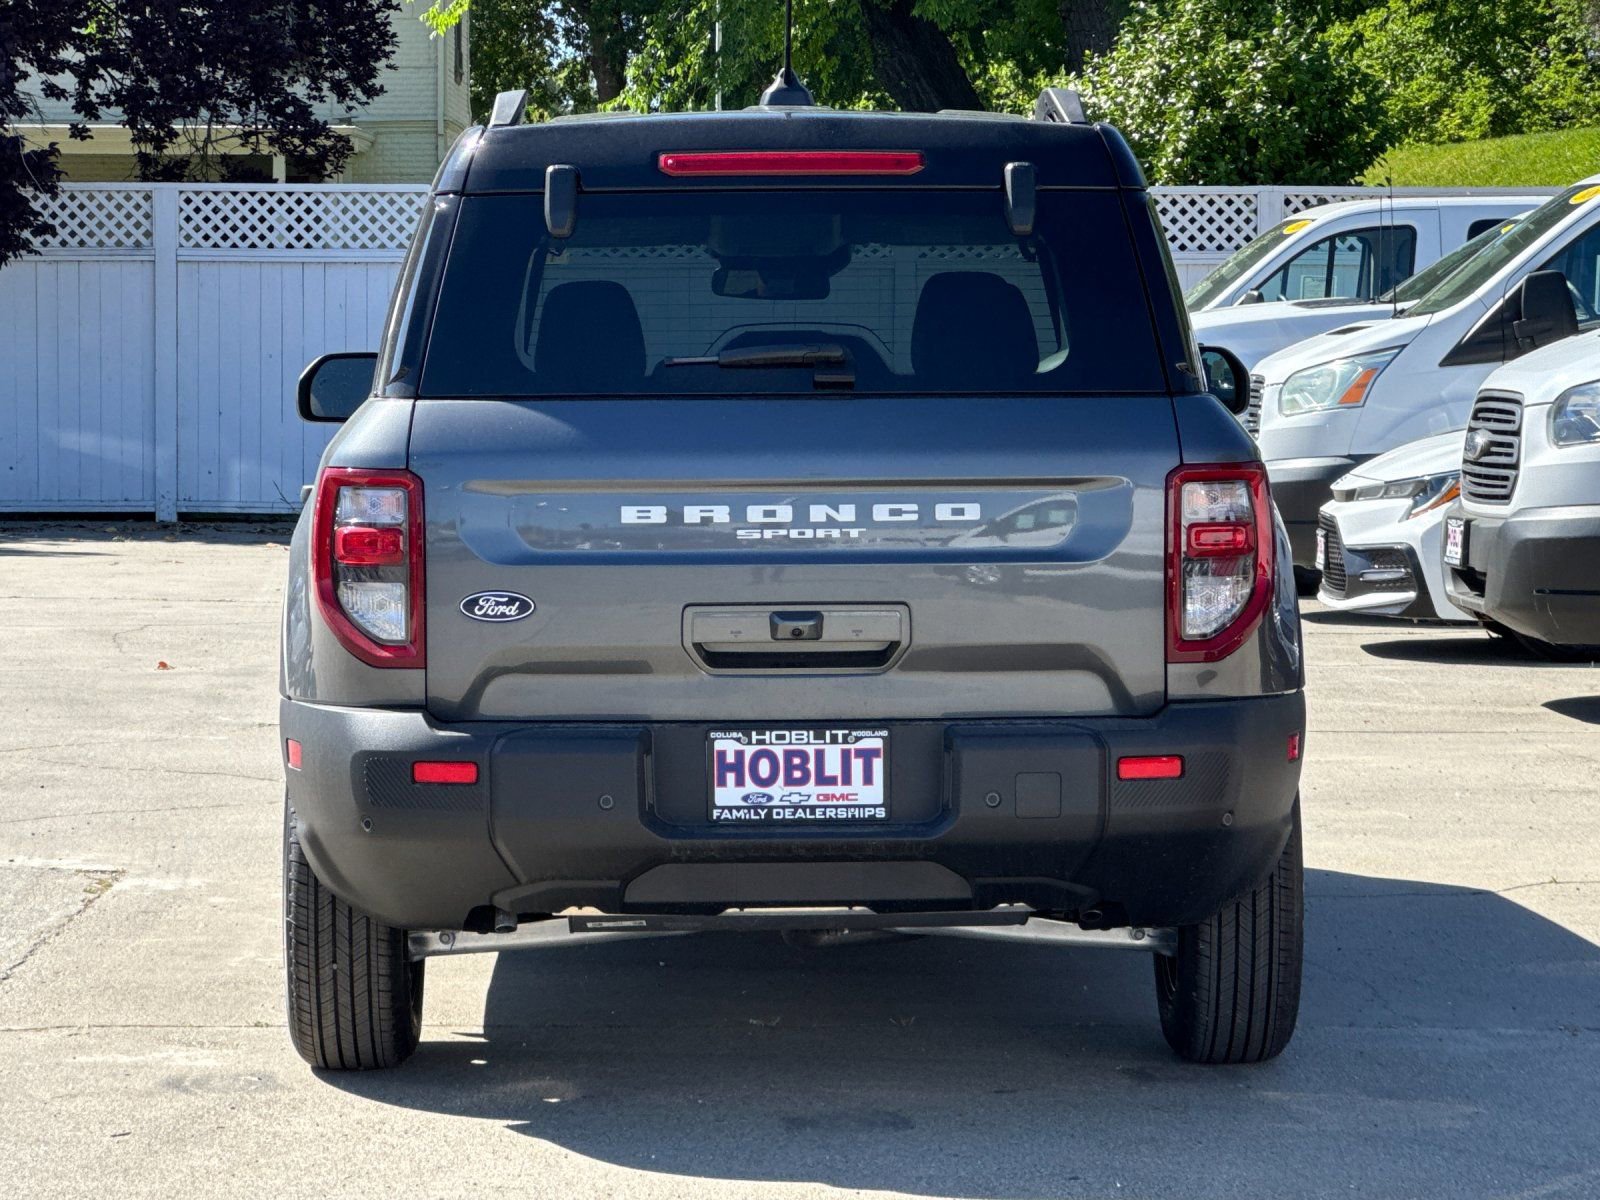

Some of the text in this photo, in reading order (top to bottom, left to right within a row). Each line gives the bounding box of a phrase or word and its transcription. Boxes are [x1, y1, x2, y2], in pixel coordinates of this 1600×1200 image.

[620, 502, 981, 524] BRONCO
[736, 528, 866, 539] SPORT
[474, 596, 520, 615] Ford
[710, 731, 743, 739] COLUSA
[751, 730, 849, 744] HOBLIT
[714, 747, 883, 788] HOBLIT
[746, 792, 859, 804] Ford GMC
[772, 807, 886, 820] DEALERSHIPS
